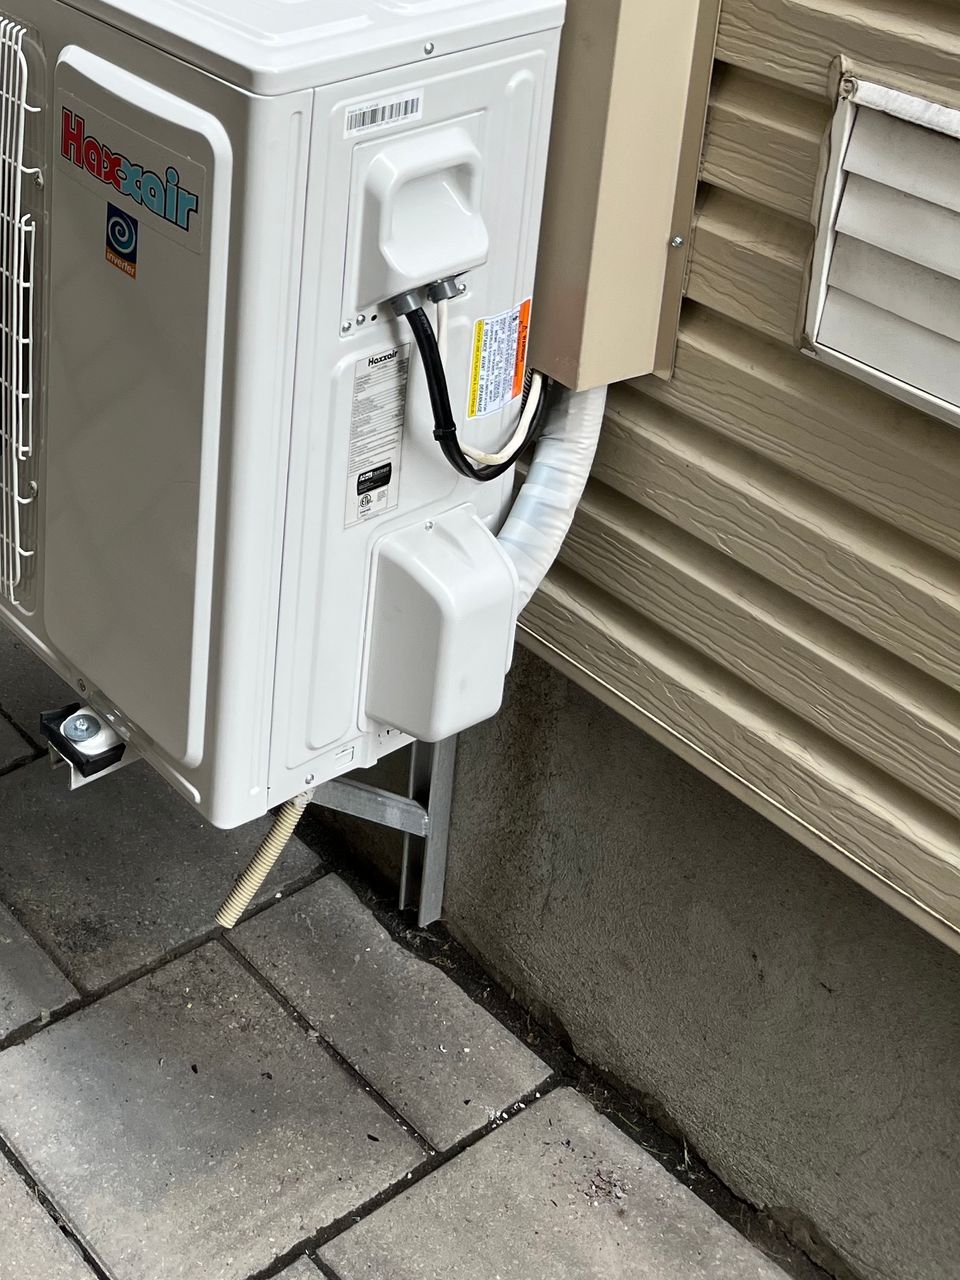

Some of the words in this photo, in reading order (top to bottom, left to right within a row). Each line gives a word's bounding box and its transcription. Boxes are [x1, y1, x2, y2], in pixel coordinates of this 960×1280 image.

[61, 106, 198, 232] Haxxair
[106, 250, 136, 276] inverter
[367, 349, 398, 367] Haxxair
